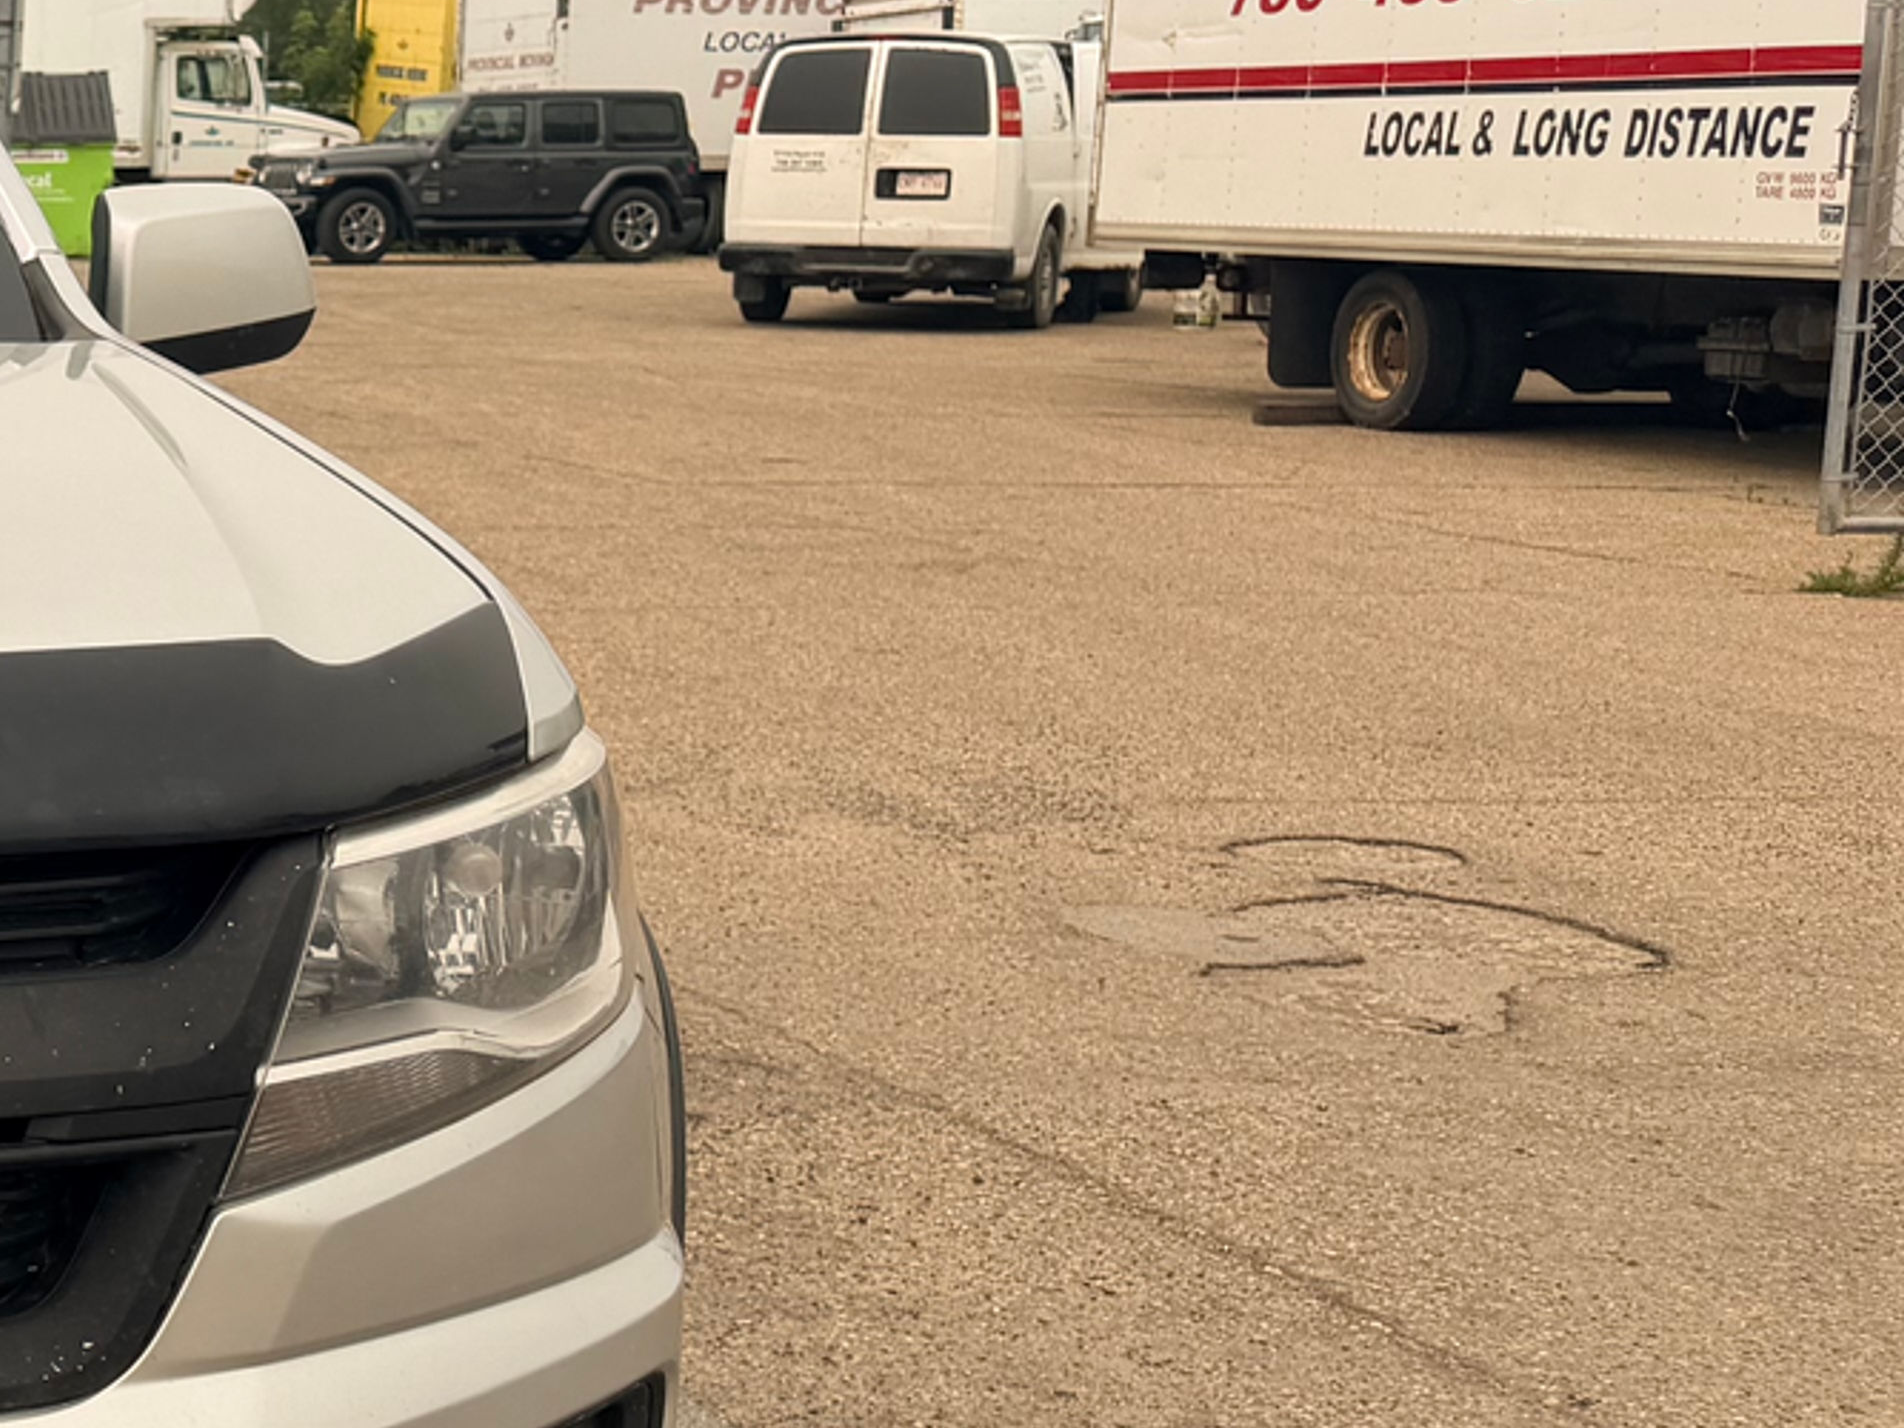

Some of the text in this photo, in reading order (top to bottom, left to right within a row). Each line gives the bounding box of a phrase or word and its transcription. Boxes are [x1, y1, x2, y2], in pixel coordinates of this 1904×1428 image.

[1363, 105, 1817, 158] LOCAL & LONG DISTANCE
